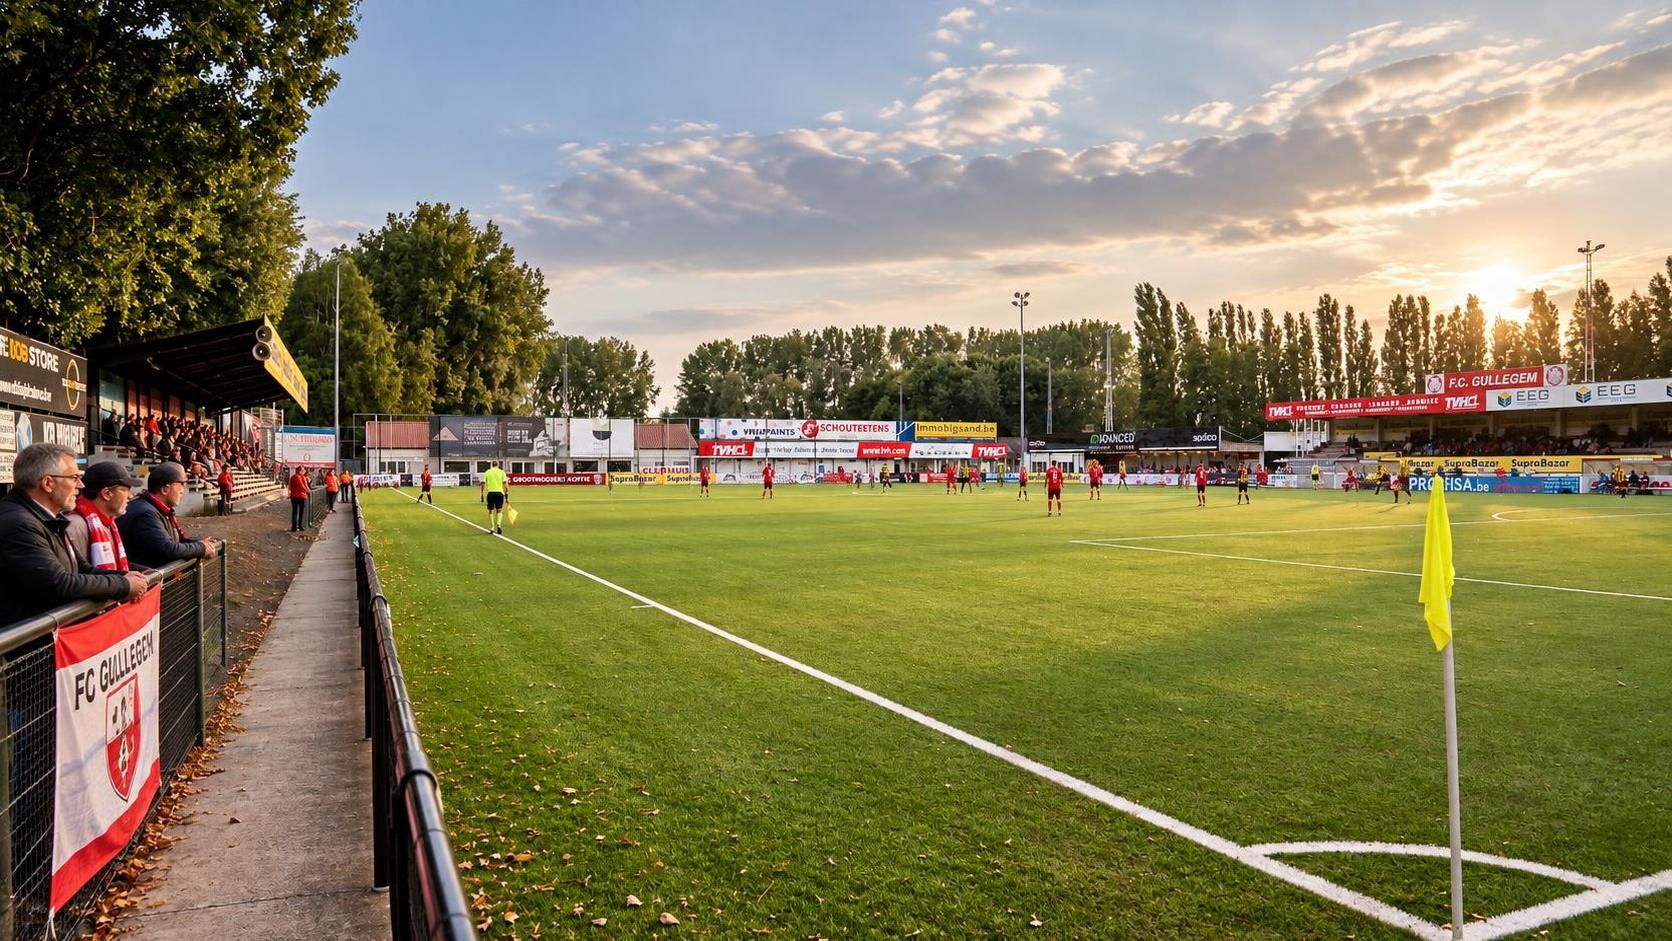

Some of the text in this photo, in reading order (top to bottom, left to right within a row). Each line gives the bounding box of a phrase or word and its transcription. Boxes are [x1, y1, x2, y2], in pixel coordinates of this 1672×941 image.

[29, 346, 59, 373] STORE
[1449, 372, 1537, 388] F.C. GULLEGEM
[1516, 390, 1549, 401] EEG
[1597, 383, 1636, 397] EEG
[820, 423, 889, 432] SCHOUTEETENS
[75, 668, 96, 710] FC
